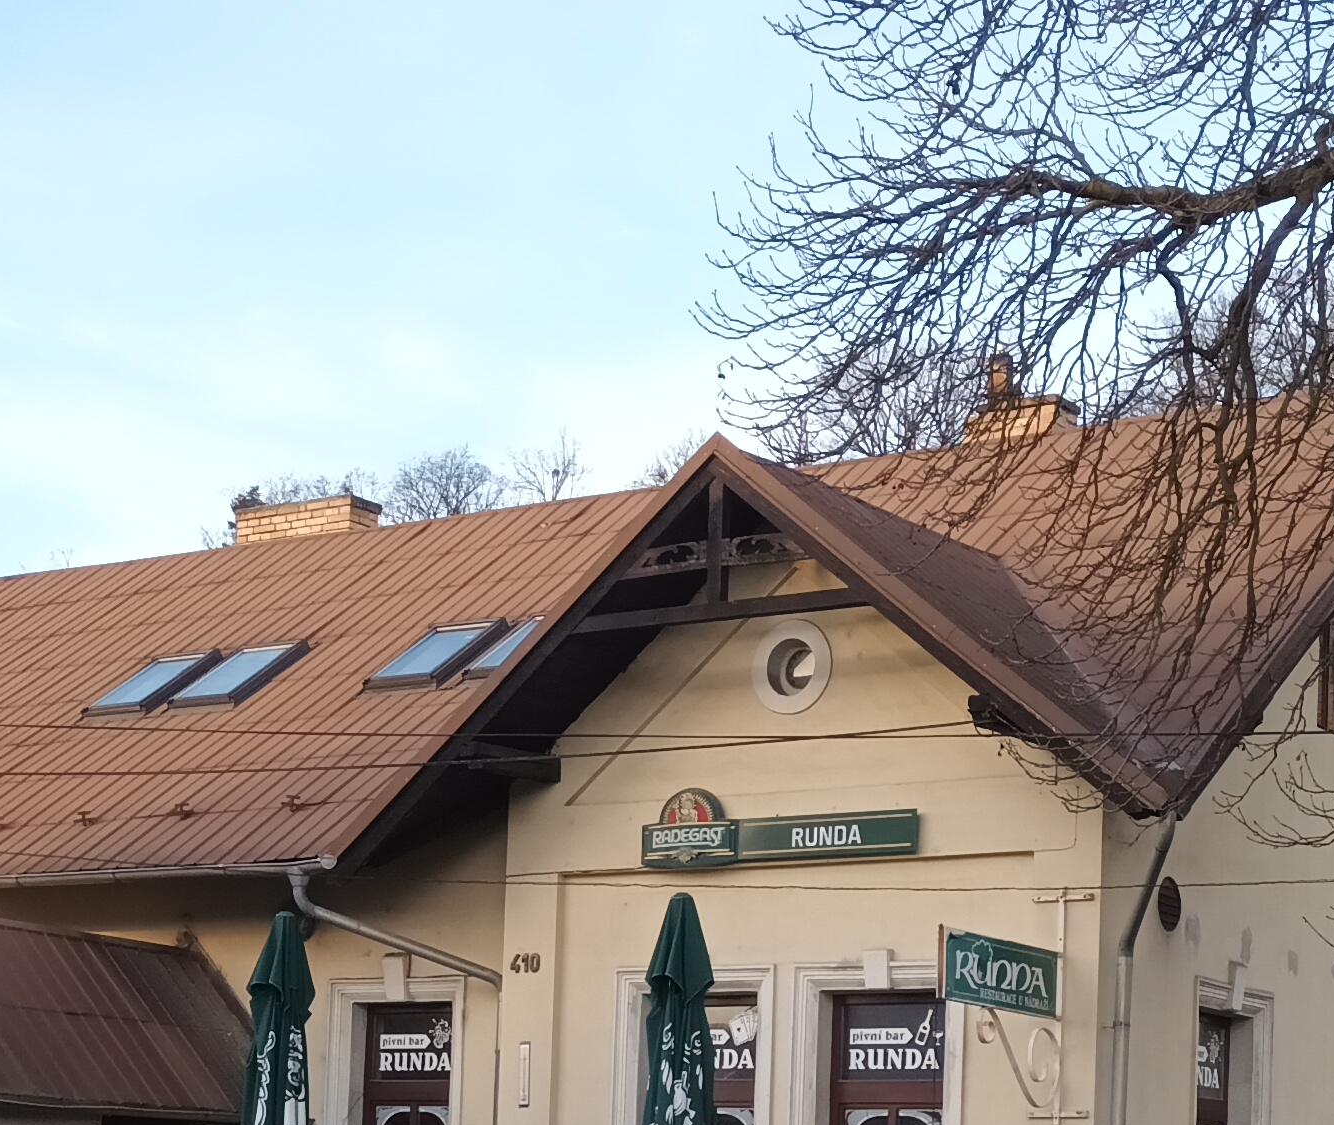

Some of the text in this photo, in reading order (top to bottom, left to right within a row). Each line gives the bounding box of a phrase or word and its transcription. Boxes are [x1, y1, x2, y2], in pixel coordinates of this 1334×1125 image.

[652, 826, 725, 849] RADEGAST
[791, 824, 862, 848] RUNDA
[510, 953, 541, 974] 410
[382, 1037, 425, 1048] pivní bar
[852, 1030, 905, 1043] pivní bar
[378, 1052, 452, 1072] RUNDA
[848, 1048, 940, 1070] RUNDA
